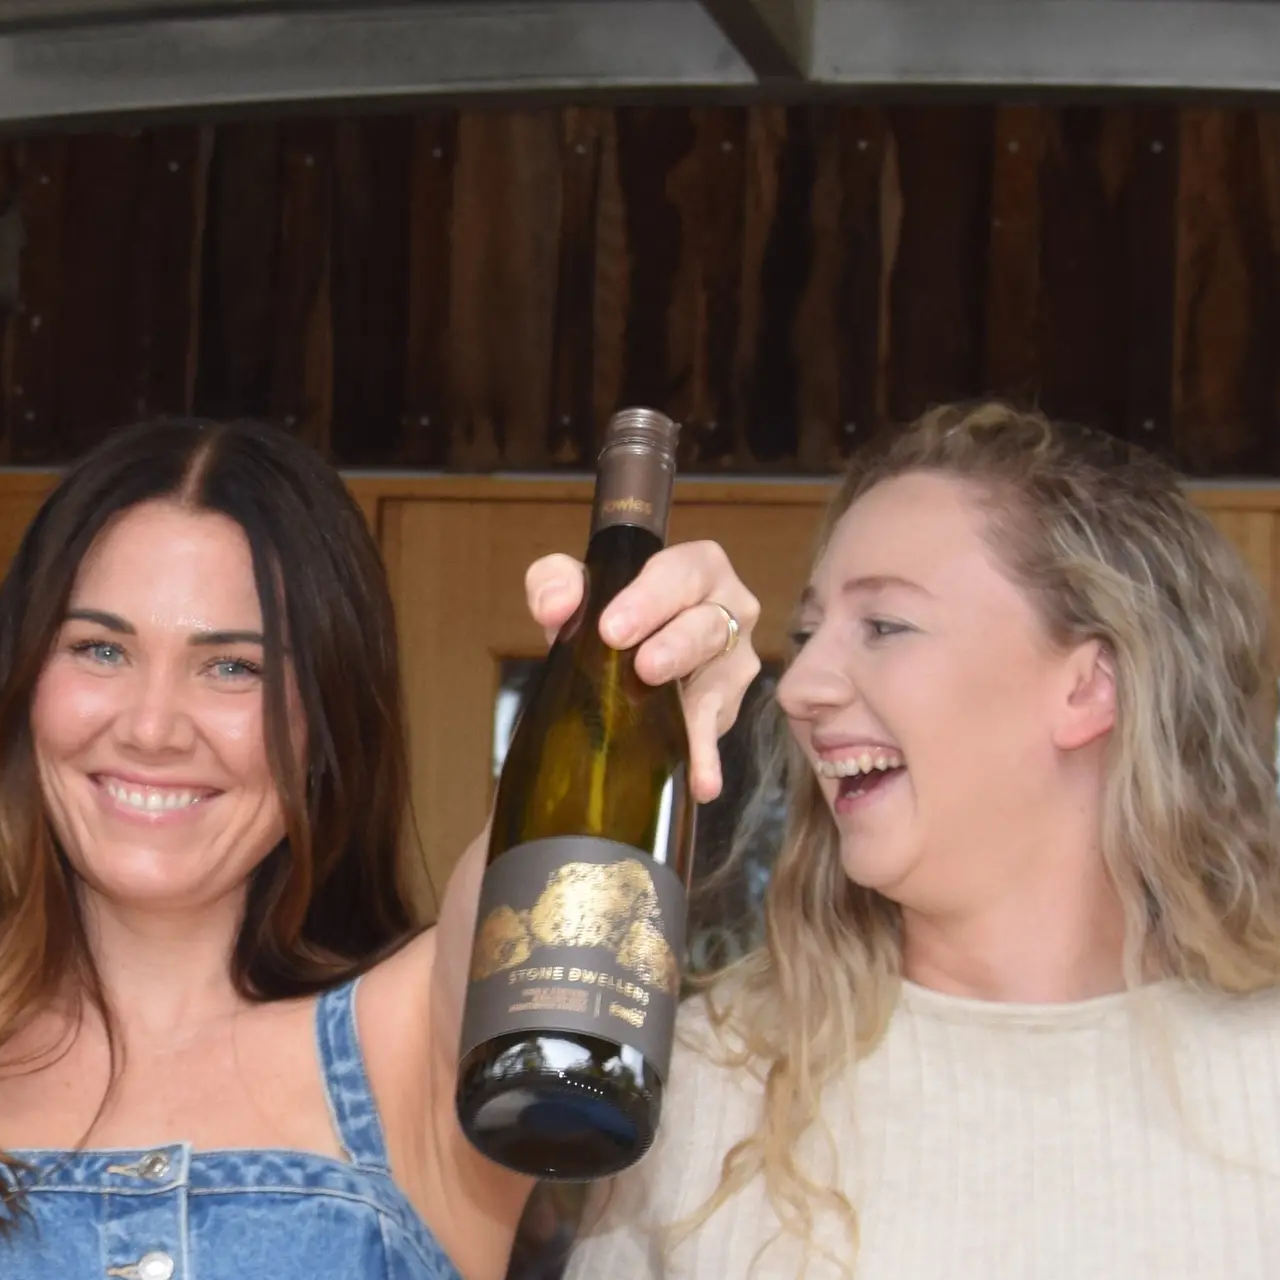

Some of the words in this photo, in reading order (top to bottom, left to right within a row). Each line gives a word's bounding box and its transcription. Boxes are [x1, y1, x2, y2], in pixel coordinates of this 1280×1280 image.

[601, 496, 652, 517] owles
[508, 966, 564, 985] STONE
[568, 967, 650, 1006] DWELLERS
